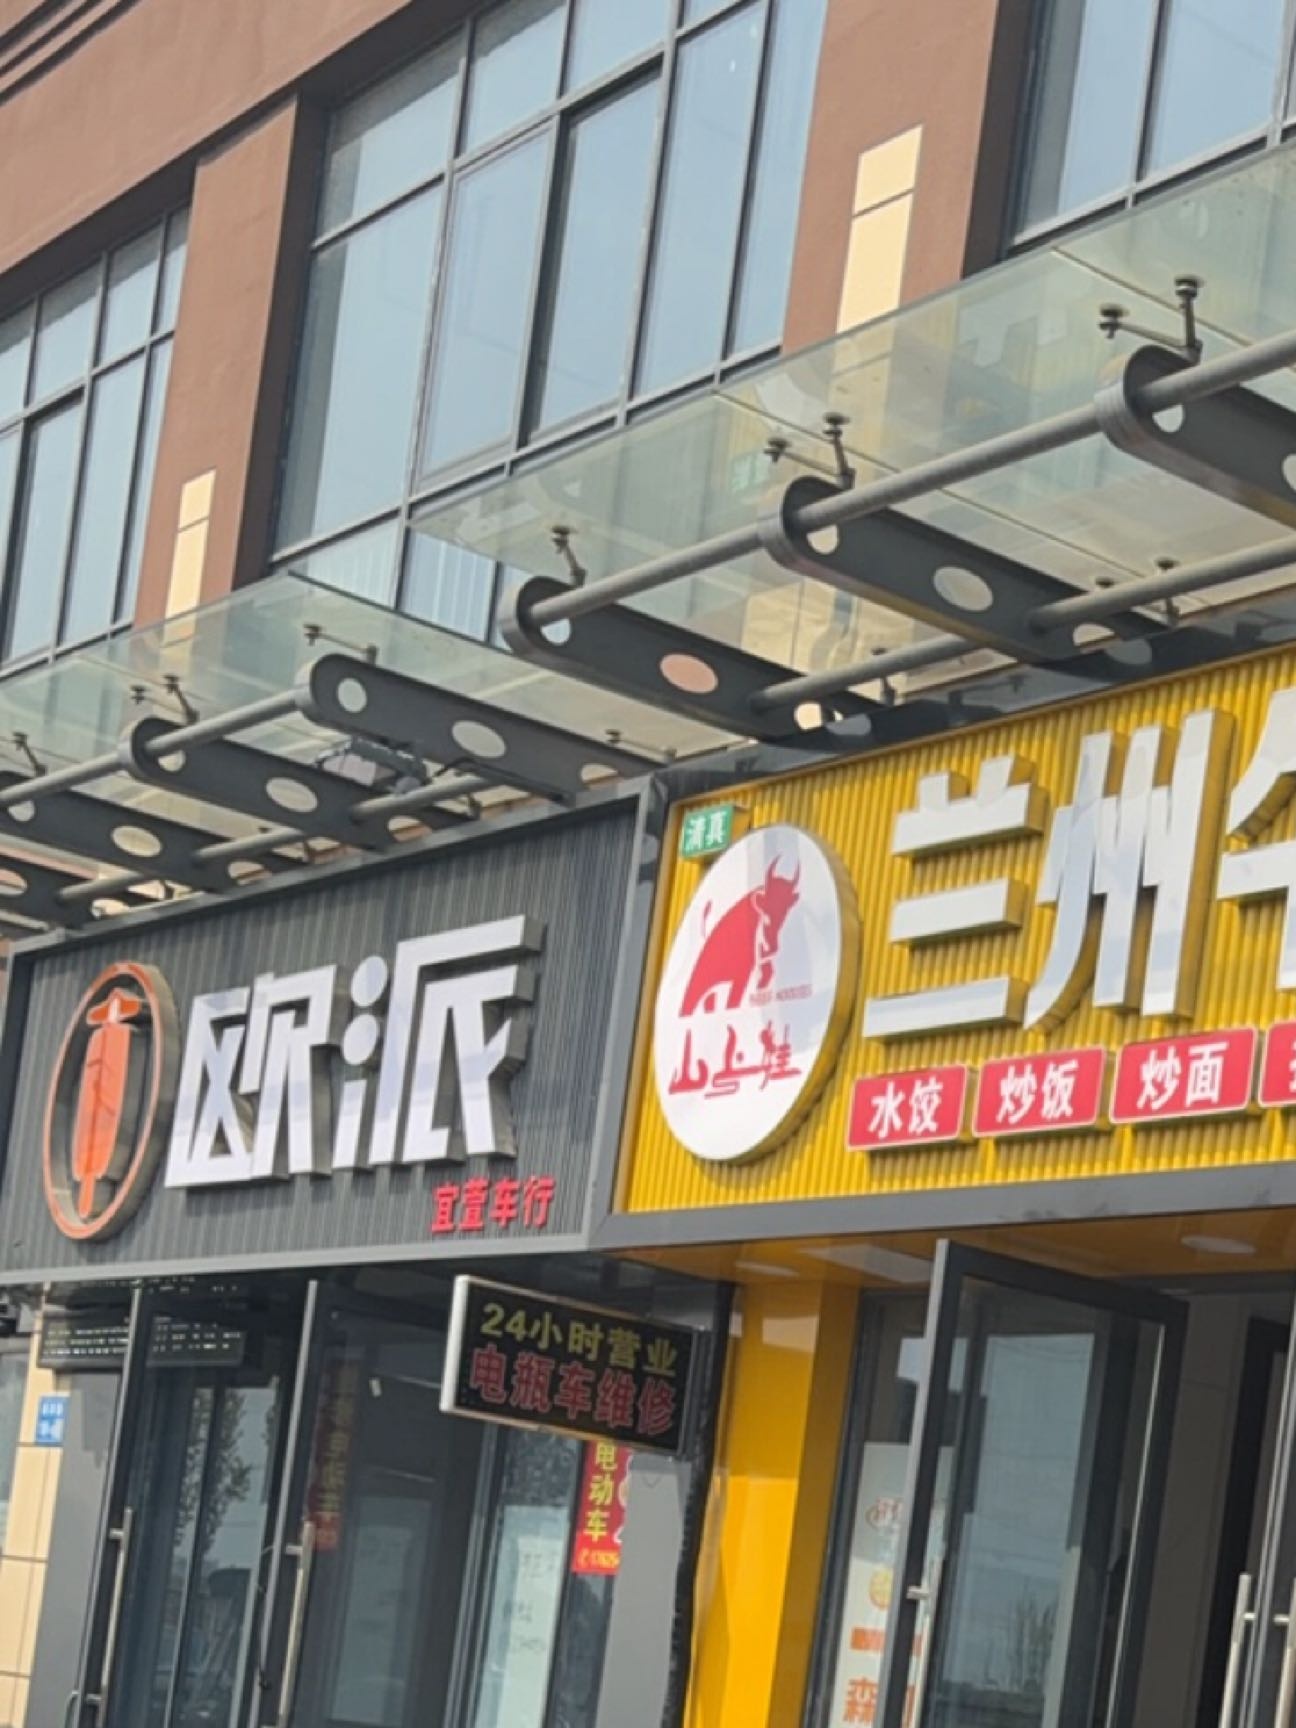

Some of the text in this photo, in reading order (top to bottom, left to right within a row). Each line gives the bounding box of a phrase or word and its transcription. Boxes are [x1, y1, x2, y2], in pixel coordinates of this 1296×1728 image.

[165, 914, 526, 1188] 欧派
[867, 1076, 943, 1139] 水饺
[996, 1057, 1082, 1127] 炒饭
[1135, 1042, 1226, 1113] 炒面
[480, 1302, 678, 1377] 24小时营业
[468, 1342, 677, 1436] 电瓶车维修
